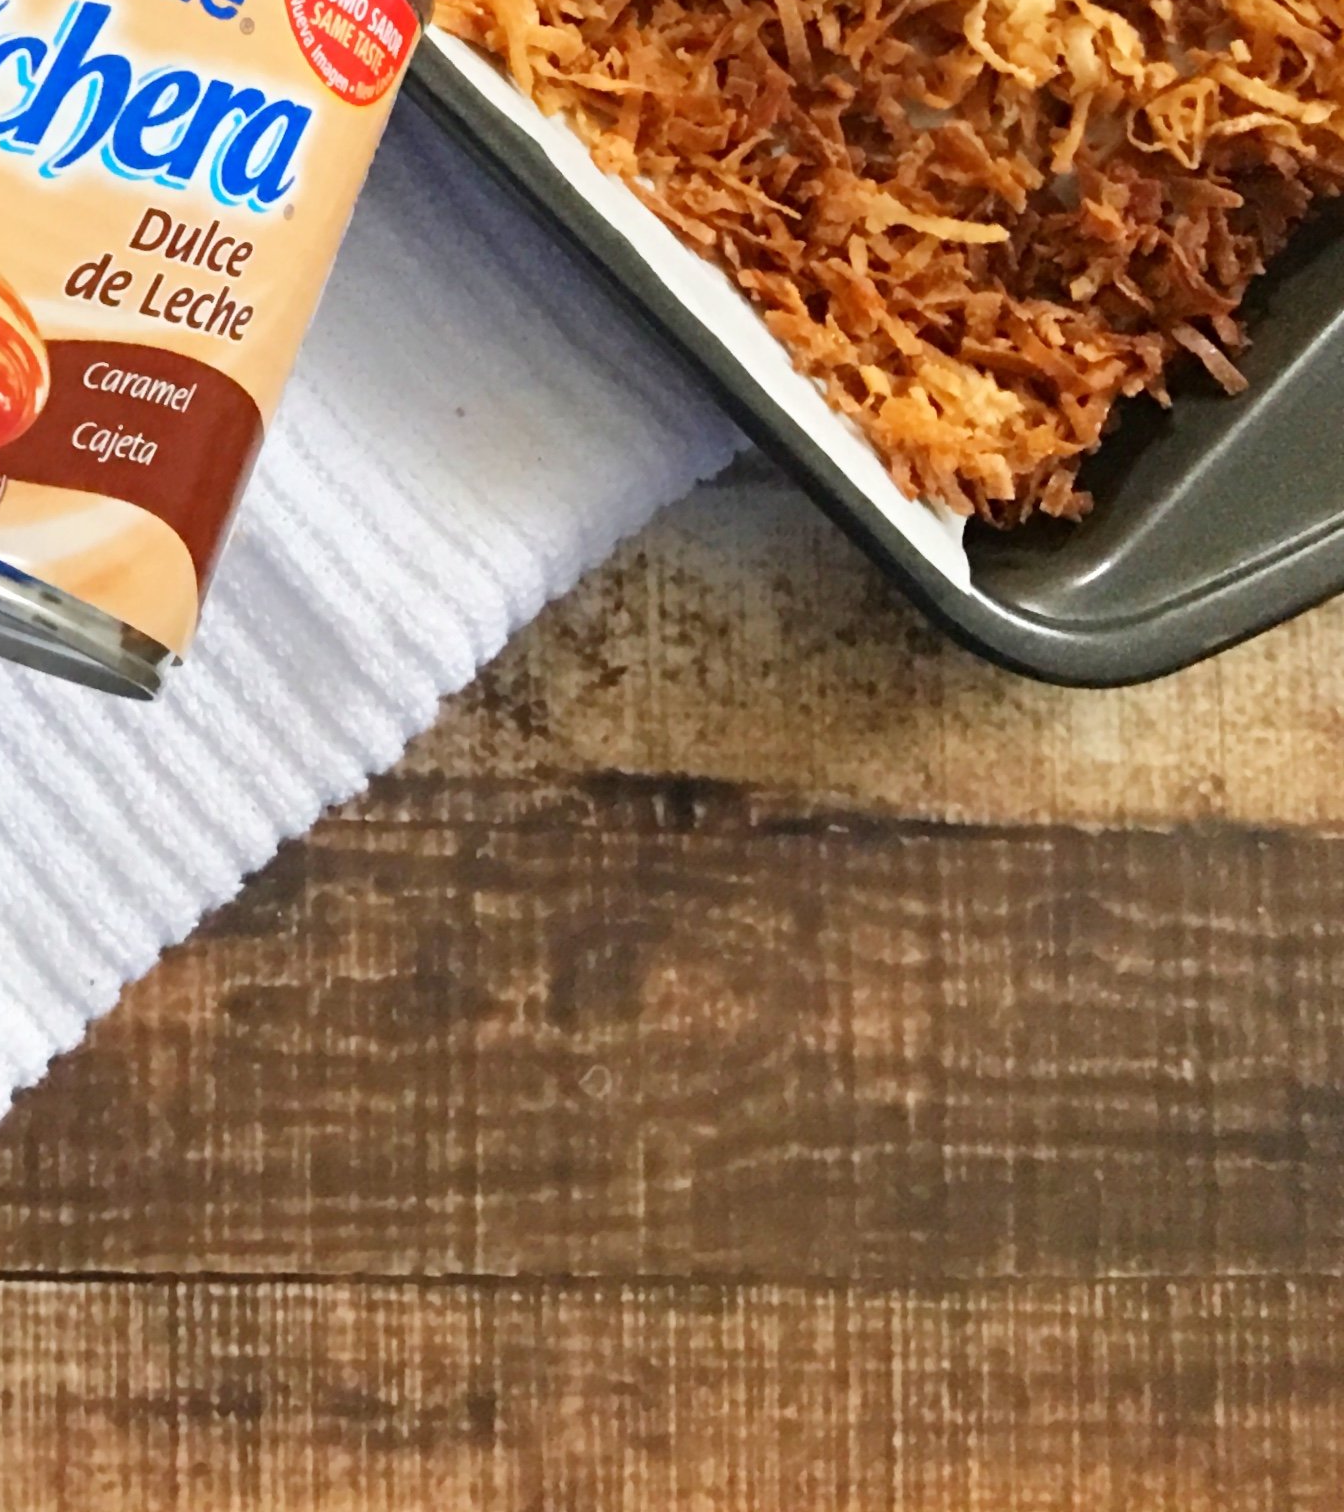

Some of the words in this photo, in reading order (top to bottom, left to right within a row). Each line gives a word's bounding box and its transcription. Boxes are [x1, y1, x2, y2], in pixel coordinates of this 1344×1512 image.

[310, 0, 356, 49] SAME
[353, 30, 386, 76] TASTE
[367, 7, 404, 59] SABOR
[128, 207, 254, 278] Dulce
[64, 253, 133, 307] de
[138, 273, 254, 341] Leche
[82, 361, 198, 413] Caramel
[71, 421, 159, 466] Cajeta
